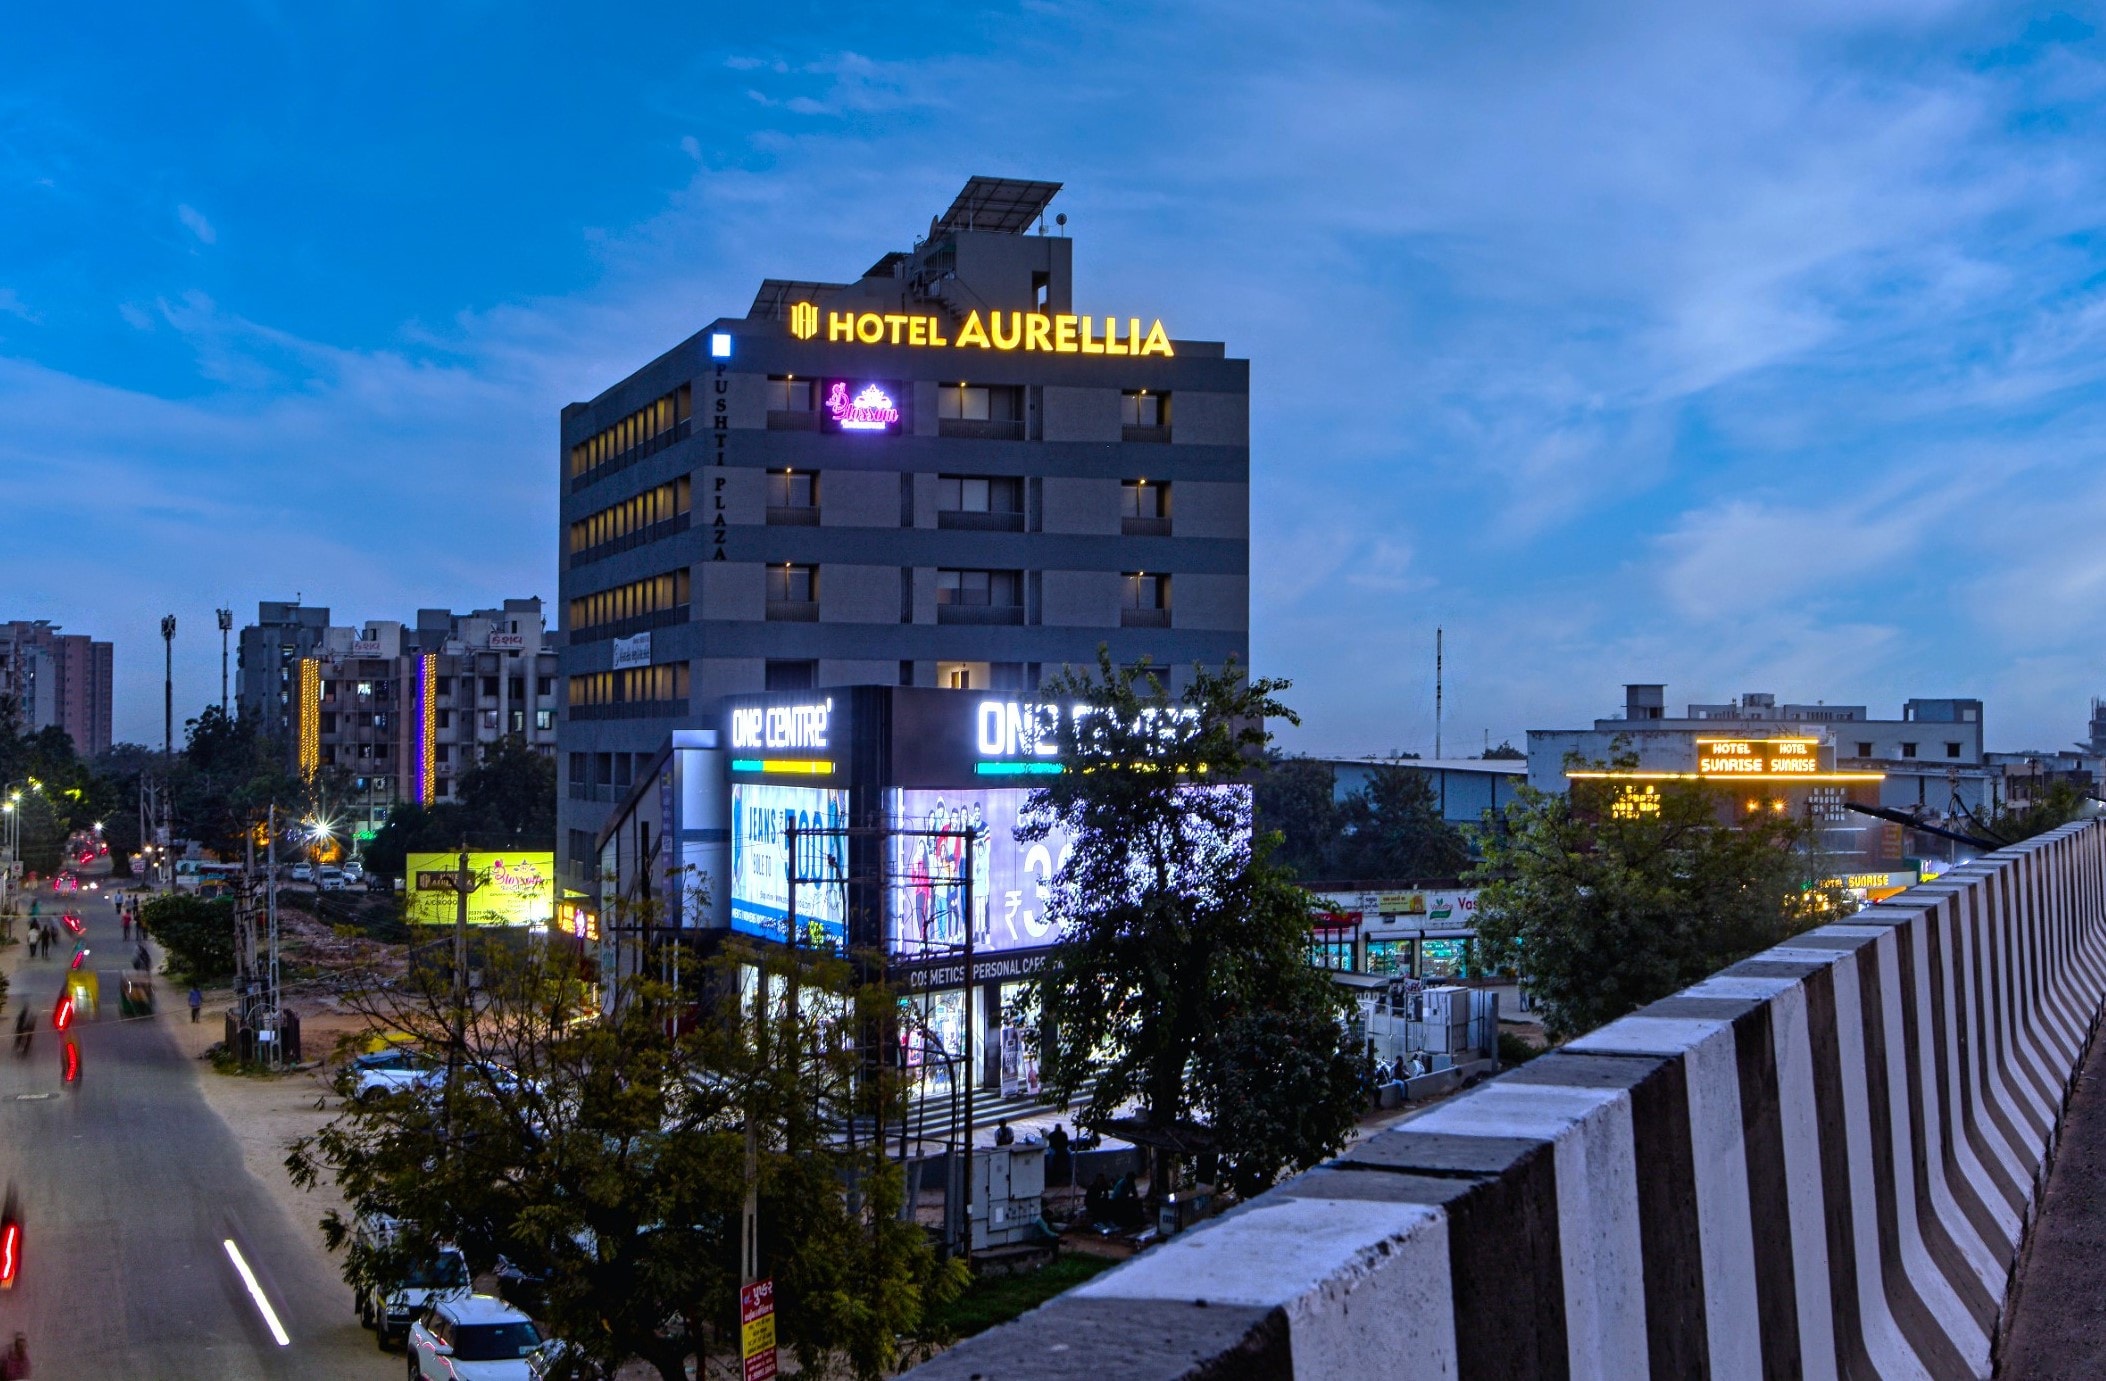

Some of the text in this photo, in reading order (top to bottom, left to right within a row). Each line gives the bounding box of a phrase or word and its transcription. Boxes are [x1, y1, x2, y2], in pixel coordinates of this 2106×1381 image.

[829, 308, 1175, 358] HOTEL AURELLIA
[712, 363, 728, 561] PUSHTI PLAZA
[1712, 743, 1751, 755] HOTEL
[1779, 743, 1808, 755] HOTEL
[1700, 758, 1763, 772] SUNRISE
[1770, 758, 1816, 772] SUNRISE
[748, 806, 776, 845] JEANS
[1848, 874, 1889, 888] SUNRISE
[972, 958, 1021, 980] PERSONAL
